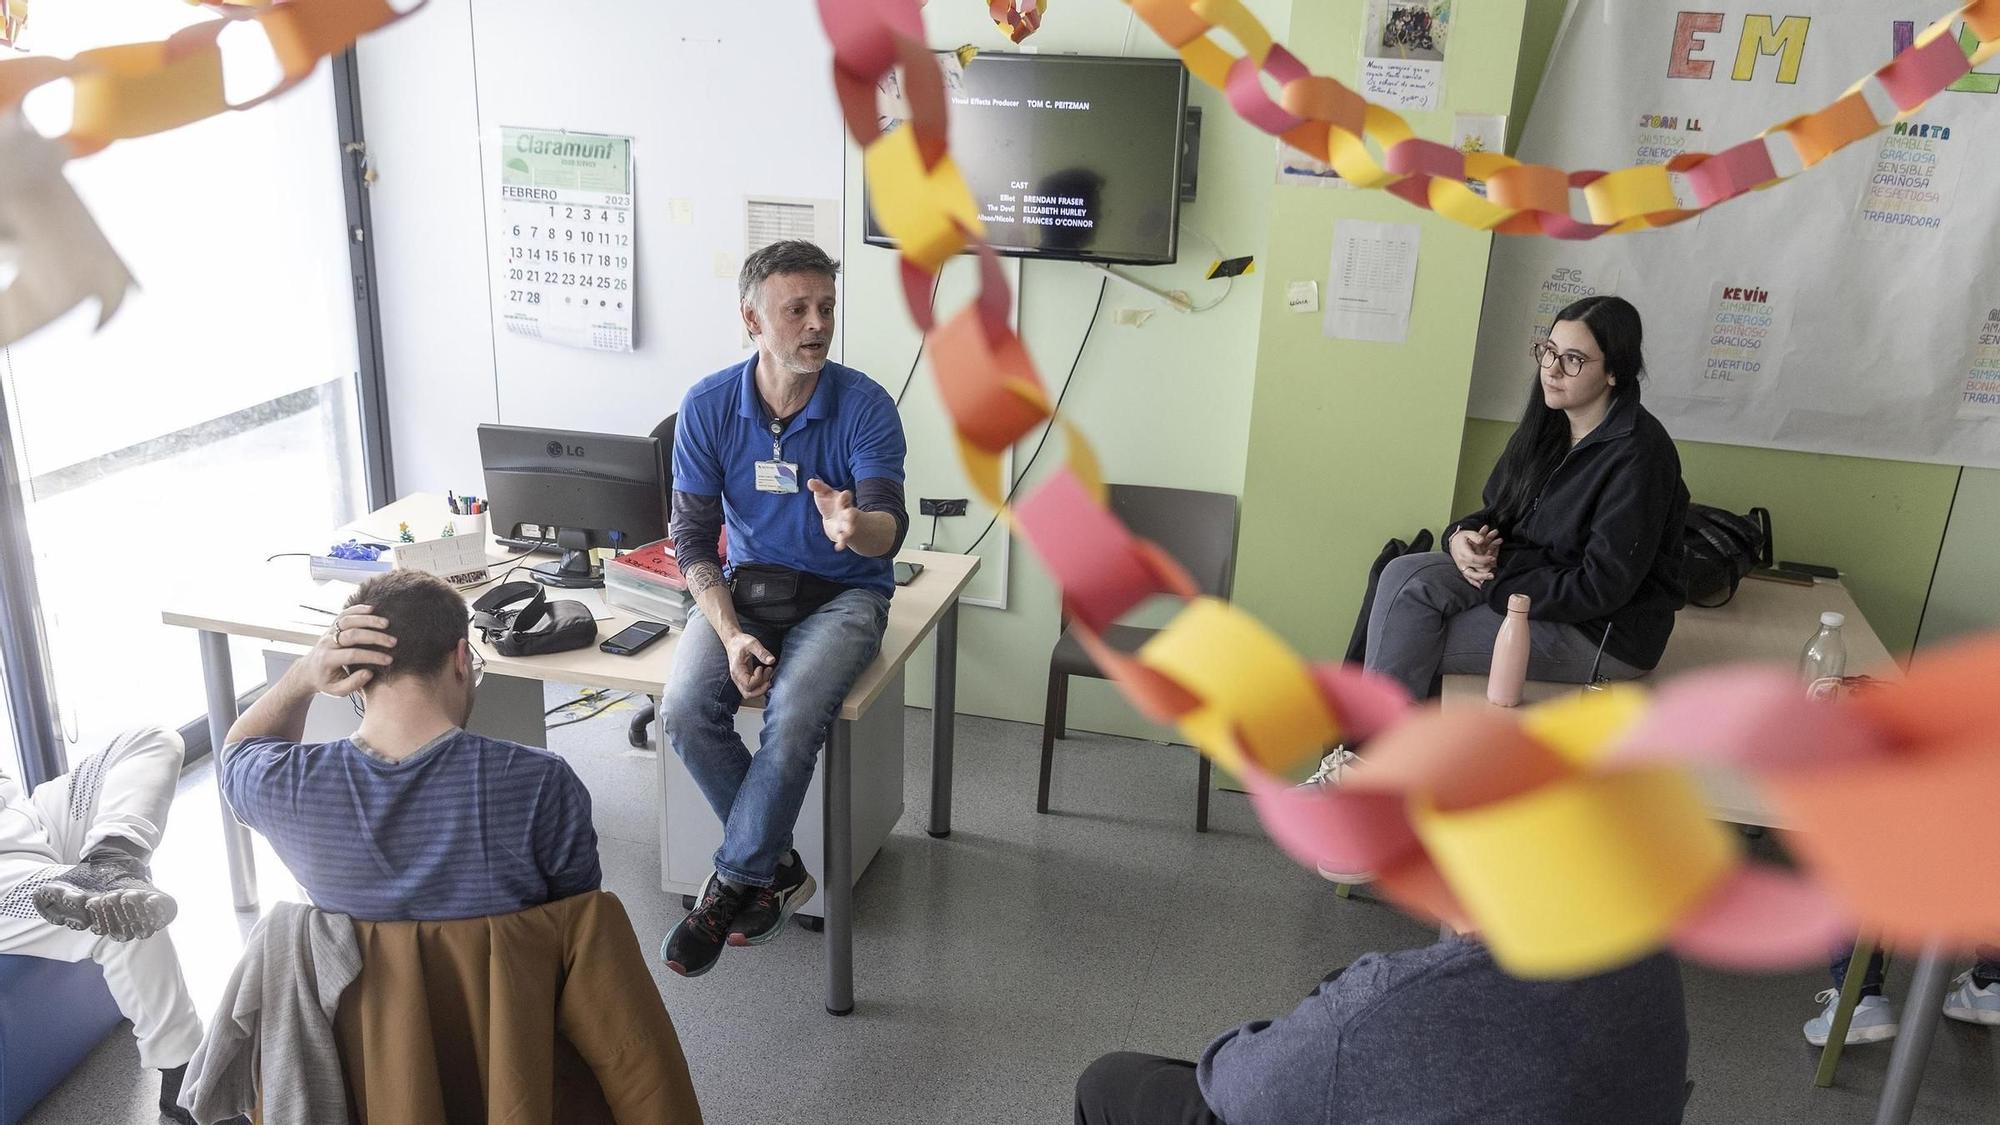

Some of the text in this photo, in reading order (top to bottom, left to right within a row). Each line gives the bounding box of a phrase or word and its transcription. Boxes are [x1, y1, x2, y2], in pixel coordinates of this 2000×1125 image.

[1667, 11, 1811, 85] EM
[970, 98, 991, 106] Effects
[993, 98, 1020, 107] Producer
[1027, 100, 1043, 108] TOM
[1055, 101, 1090, 110] PEITZMAN
[1640, 114, 1678, 130] JOAN
[1894, 121, 1950, 140] MARTA
[516, 134, 614, 160] Claramunt
[1885, 137, 1932, 152] AMABLE
[1880, 149, 1936, 164] GRACIOSA
[1876, 161, 1936, 177] SENSIBLE
[1011, 181, 1028, 190] CAST
[1872, 174, 1930, 188] CARIÑOSA
[502, 186, 558, 201] FEBRERO
[605, 195, 630, 206] 2023
[1023, 195, 1056, 204] BRENDAN
[1058, 197, 1084, 206] FRASER
[549, 206, 625, 223] 1 2 3 4 5
[1000, 204, 1015, 212] Devil
[1023, 205, 1058, 215] ELIZABETH
[1060, 207, 1087, 217] HURLEY
[1022, 216, 1053, 226] FRANCES
[1055, 218, 1093, 228] O'CONNOR
[1863, 209, 1941, 228] TRABAJADORA
[513, 225, 628, 246] 6 7 8 9 10 11 12
[510, 247, 628, 268] 13 14 15 16 17 18 19
[510, 269, 627, 290] 20 21 22 23 24 25 26
[1552, 267, 1584, 283] J.C.
[1541, 280, 1596, 296] AMISTOSO
[510, 290, 540, 304] 27 28
[1715, 312, 1772, 327] GENEROSO
[1713, 324, 1767, 338] CARIÑOSO
[1711, 335, 1761, 349] GRACIOSO
[1707, 358, 1760, 372] DIVERTIDO
[1704, 369, 1735, 382] LEAL
[566, 445, 585, 458] LG
